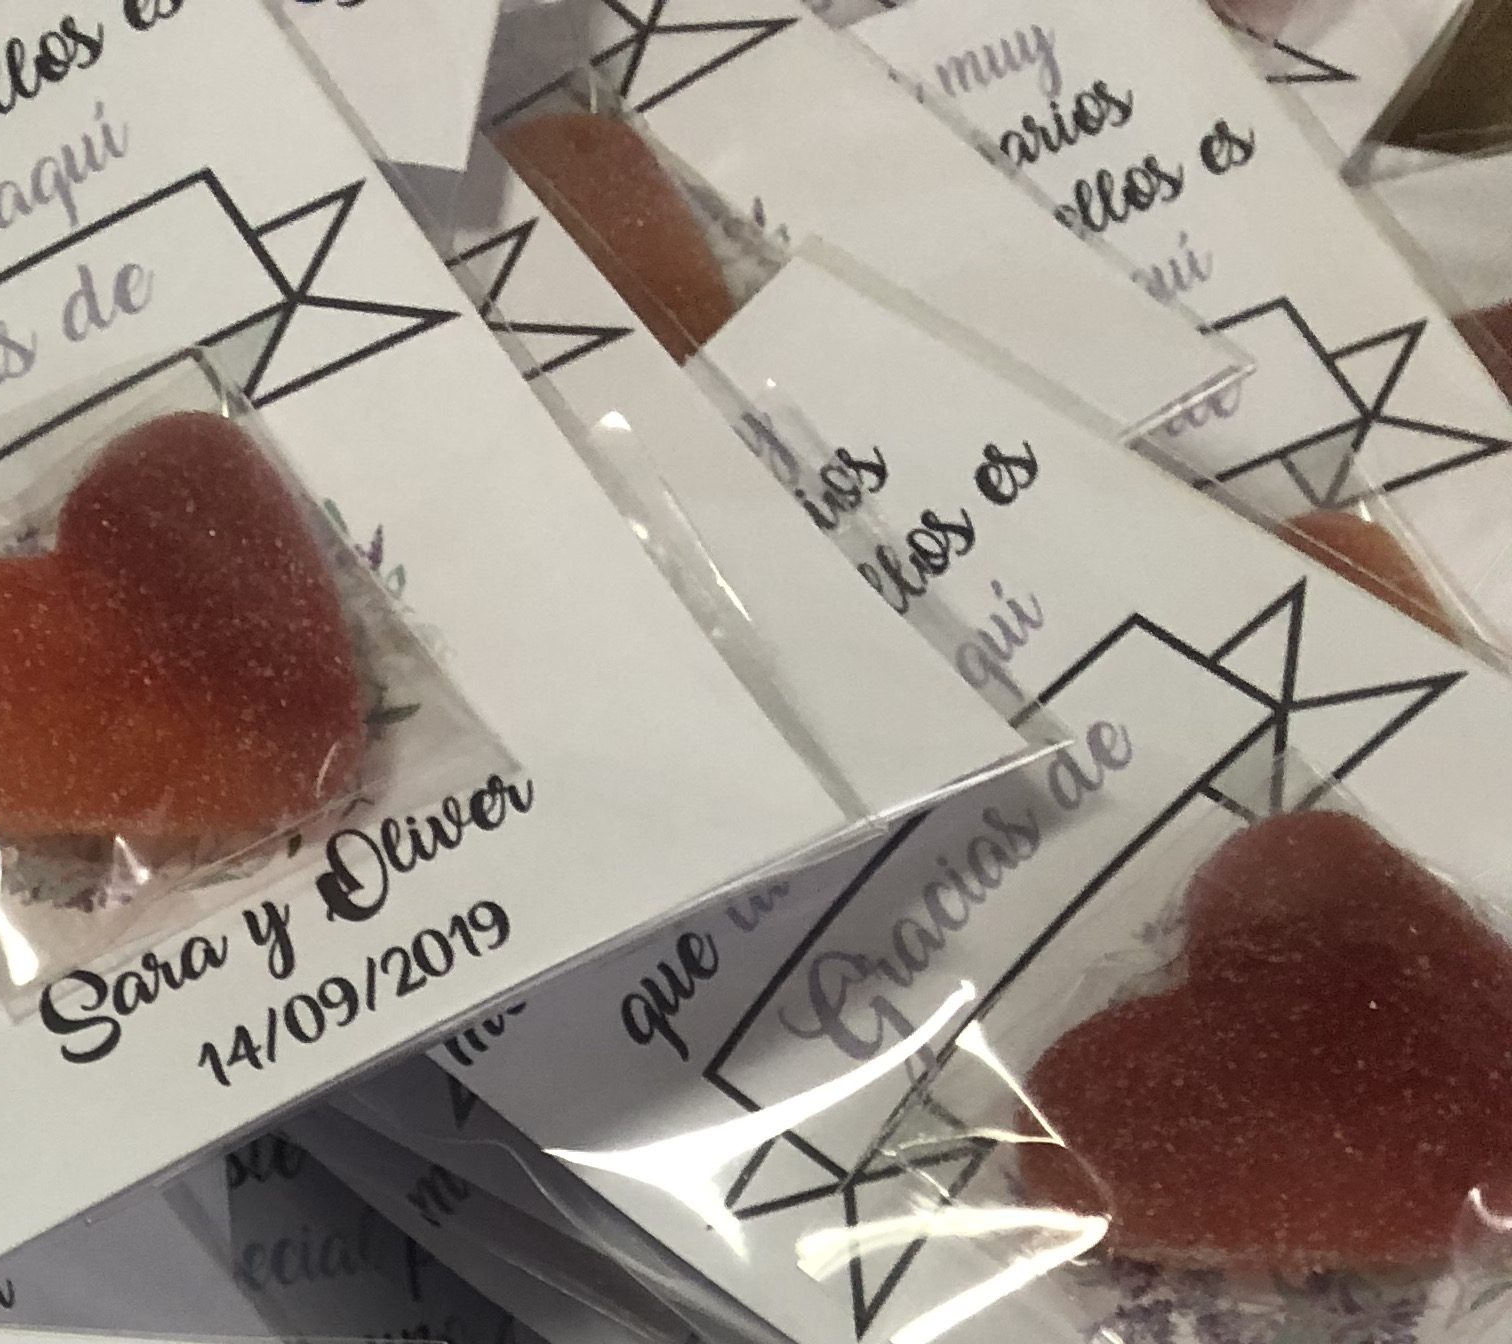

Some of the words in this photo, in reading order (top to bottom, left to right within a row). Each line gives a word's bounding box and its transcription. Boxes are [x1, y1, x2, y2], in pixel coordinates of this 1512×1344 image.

[935, 24, 1062, 98] muy
[999, 78, 1134, 168] arios
[1199, 118, 1257, 176] es
[62, 257, 154, 345] de
[857, 506, 976, 614] llos
[973, 438, 1039, 505] es
[954, 578, 1045, 702] quí
[40, 933, 228, 1064] Sara
[241, 898, 296, 981] y
[314, 773, 534, 923] Oliver
[776, 806, 1044, 1100] Gracias
[198, 898, 511, 1087] 14/09/2019
[619, 930, 722, 1062] que
